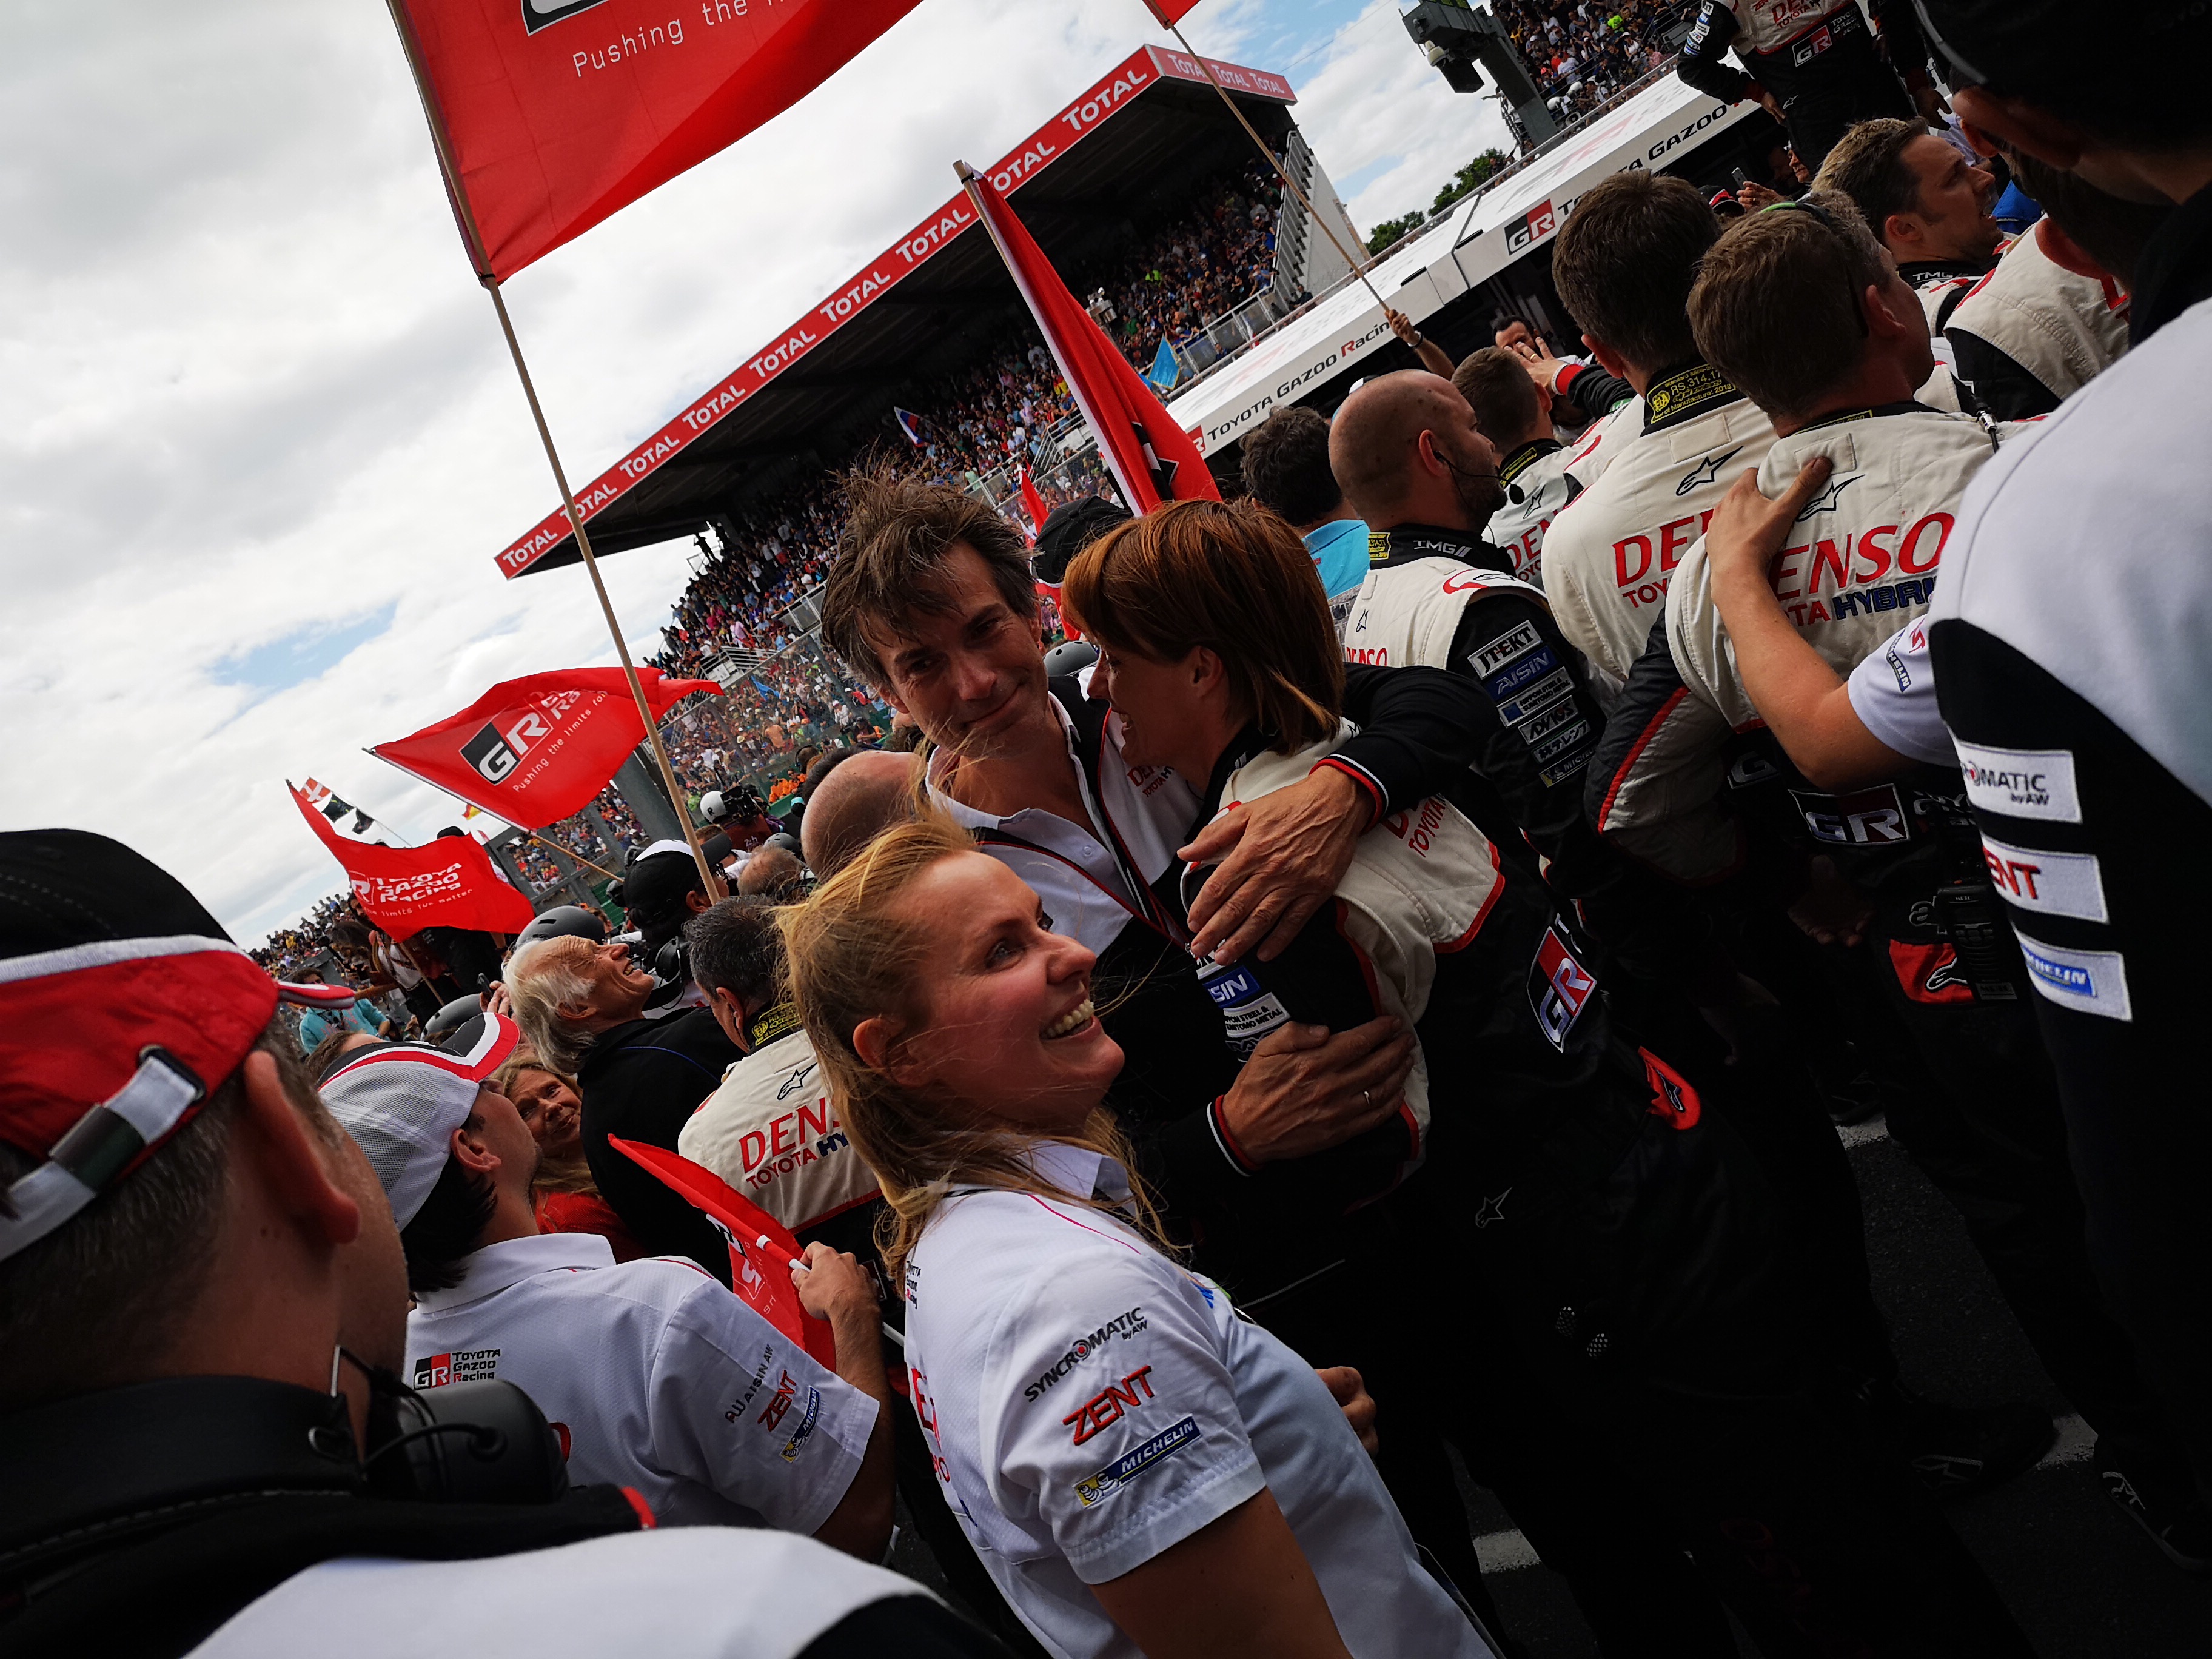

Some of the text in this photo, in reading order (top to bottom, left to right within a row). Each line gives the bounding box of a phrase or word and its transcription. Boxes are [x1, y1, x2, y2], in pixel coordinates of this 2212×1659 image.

[1777, 5, 1811, 28] TOYOTA
[572, 0, 748, 78] Pushing the
[1796, 35, 1832, 64] GR
[1167, 54, 1285, 94] TOTA TOTAL TOTAL
[1509, 104, 1728, 253] GR GAZOO
[1912, 270, 1954, 281] TMG
[502, 529, 557, 569] TOTAL
[619, 435, 680, 479] TOTAL
[682, 384, 746, 430] TOTAL
[749, 330, 817, 378] TOTAL
[820, 270, 891, 322] TOTAL
[896, 209, 971, 264] TOTAL
[1062, 69, 1147, 131] TOTAL
[1207, 395, 1273, 441] TOYOTA
[1276, 354, 1338, 398] GAZOO
[1341, 321, 1390, 357] Racin
[1518, 558, 1541, 583] OYO
[1768, 512, 1956, 602] ENSO
[1623, 582, 1667, 608] TOY
[1833, 577, 1937, 620] HYBRI
[1476, 626, 1534, 674] JTEKT
[1496, 652, 1549, 695] AISIN
[1519, 689, 1543, 706] NIPPON
[1542, 680, 1558, 693] STEEL
[1523, 690, 1553, 712] SUMITOMO
[479, 712, 549, 782] GR
[512, 757, 549, 793] Pushing
[548, 737, 564, 755] the
[563, 709, 592, 737] limits
[1563, 746, 1594, 771] MICHEL
[1731, 751, 1780, 785] G
[1959, 760, 2046, 793] OMATIC
[707, 806, 715, 816] R
[1408, 798, 1446, 858] TOYOTA
[1805, 809, 1908, 843] GR
[351, 880, 371, 903] R
[1982, 846, 2041, 900] ENT
[381, 908, 412, 917] limits
[1208, 974, 1248, 1003] SIN
[2025, 953, 2086, 985] HELIN
[1225, 1008, 1283, 1031] MITOMO METAL
[1240, 1010, 1263, 1022] STEEL
[1261, 1005, 1270, 1014] &
[1540, 957, 1592, 1043] GR
[738, 1096, 842, 1174] DEN
[746, 1148, 818, 1190] TOYOTA
[414, 1349, 501, 1389] GR TOYOTA
[452, 1360, 496, 1372] GAZOO
[744, 1362, 769, 1404] AISIN
[763, 1343, 774, 1364] AW
[1024, 1306, 1145, 1403] SYNCROMATIC
[453, 1371, 495, 1383] Racing
[757, 1369, 797, 1432] ZENT
[1062, 1364, 1156, 1446] ZENT
[1120, 1421, 1194, 1473] MICHELIN
